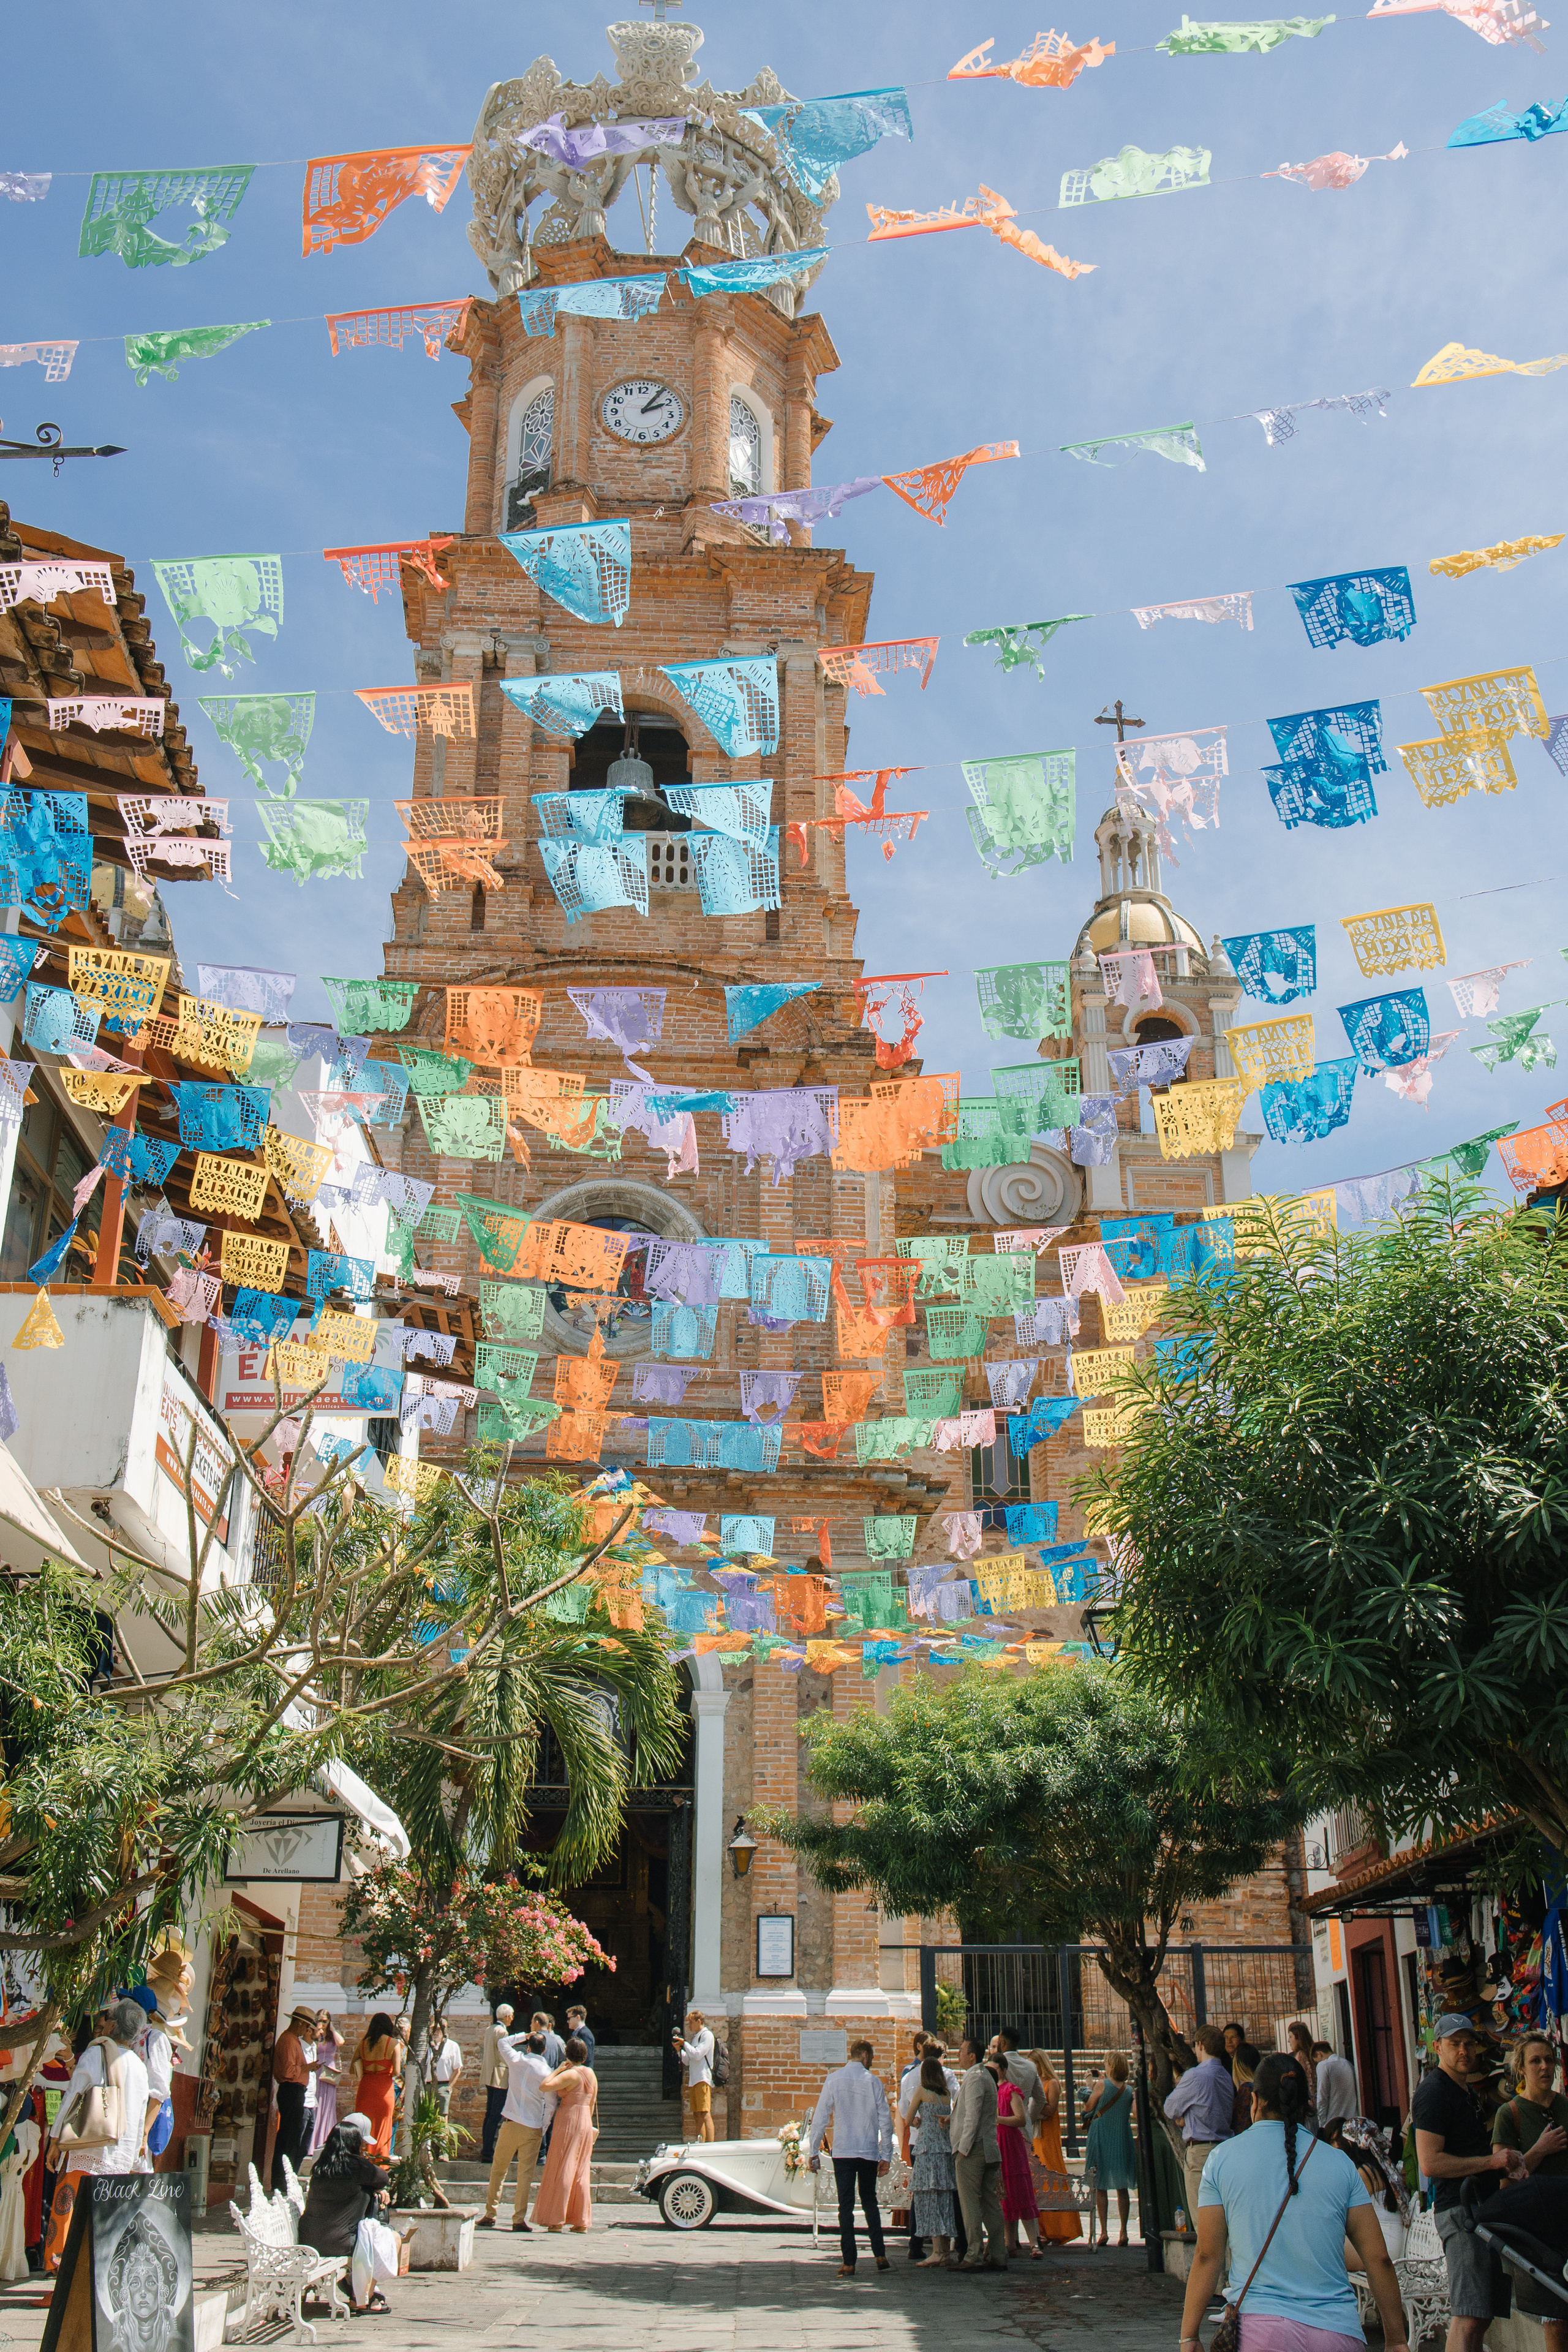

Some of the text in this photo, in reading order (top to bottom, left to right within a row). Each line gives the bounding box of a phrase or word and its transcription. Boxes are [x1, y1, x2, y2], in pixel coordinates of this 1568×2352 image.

[1434, 674, 1526, 702] REYNA DE
[1426, 758, 1498, 786] MEXO
[1352, 910, 1430, 933] REYNA DE
[77, 951, 163, 979] REYNA DE
[75, 980, 149, 1005] MEXICO
[238, 1015, 257, 1033] DE
[311, 1148, 328, 1166] DE
[203, 1158, 265, 1185] REYNA DE
[201, 1178, 255, 1204] MEXICO
[322, 1310, 373, 1332] REYNA DE
[318, 1327, 365, 1349] MEXICO
[160, 1396, 178, 1431] EATS
[1088, 1412, 1115, 1422] REYN
[195, 1448, 213, 1487] CKETS
[250, 1819, 276, 1827] Joyería
[93, 2177, 184, 2201] Black Line
